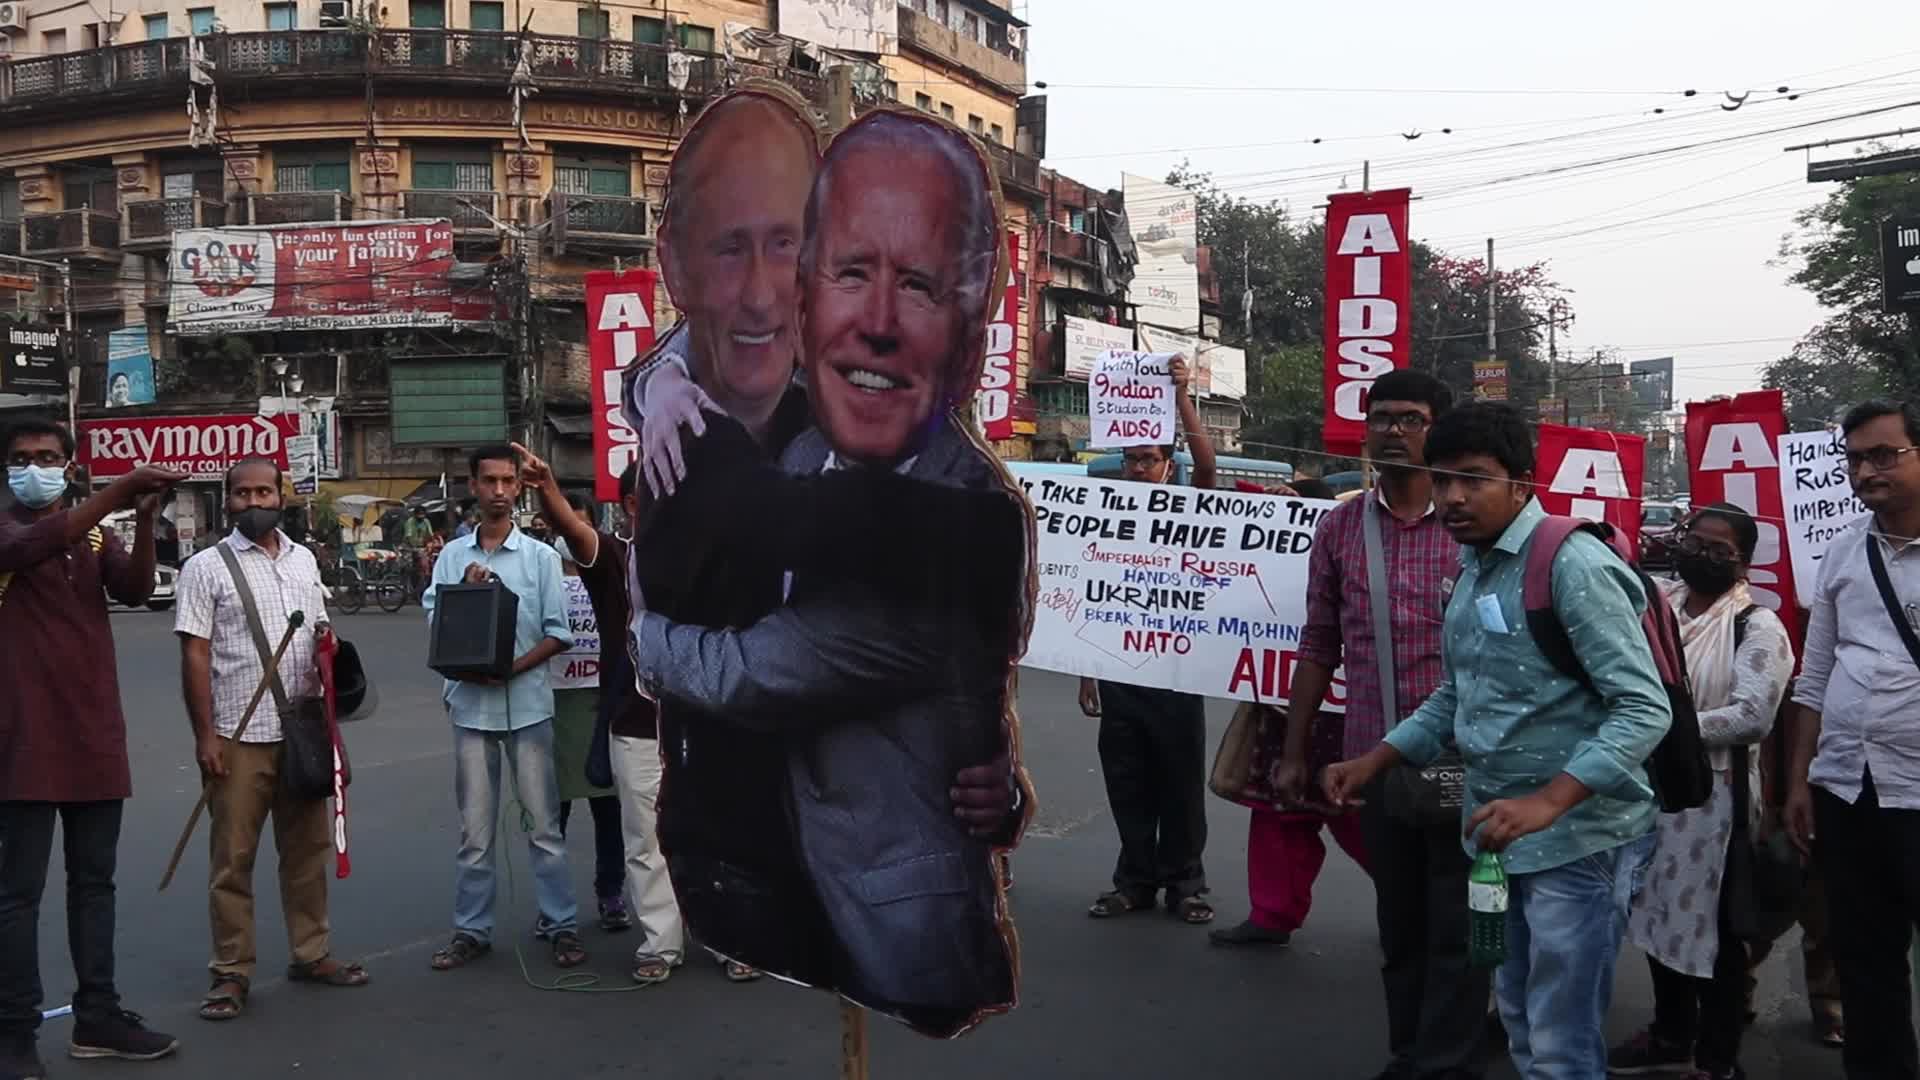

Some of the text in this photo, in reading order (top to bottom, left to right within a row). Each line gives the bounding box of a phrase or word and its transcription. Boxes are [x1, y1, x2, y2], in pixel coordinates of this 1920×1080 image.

[391, 103, 506, 119] AMULA
[425, 228, 450, 244] for
[294, 247, 339, 270] your
[981, 267, 1016, 422] DSO
[1134, 354, 1169, 376] You
[1106, 419, 1162, 440] AIDSO
[1042, 480, 1088, 505] TAKE
[1100, 486, 1139, 511] TILL
[1147, 489, 1186, 514] BE
[1195, 493, 1276, 519] KNOWS
[1036, 505, 1313, 554] PEOPLE HAVE DIED
[1181, 552, 1256, 578] RUSSIA
[1123, 568, 1181, 587] HANDS
[1190, 576, 1232, 589] OFF
[1086, 579, 1206, 613] UKRAINE
[1084, 608, 1134, 627] BREAK
[1140, 612, 1165, 630] THE
[1169, 615, 1211, 638] WAR
[1123, 630, 1192, 659] NATO
